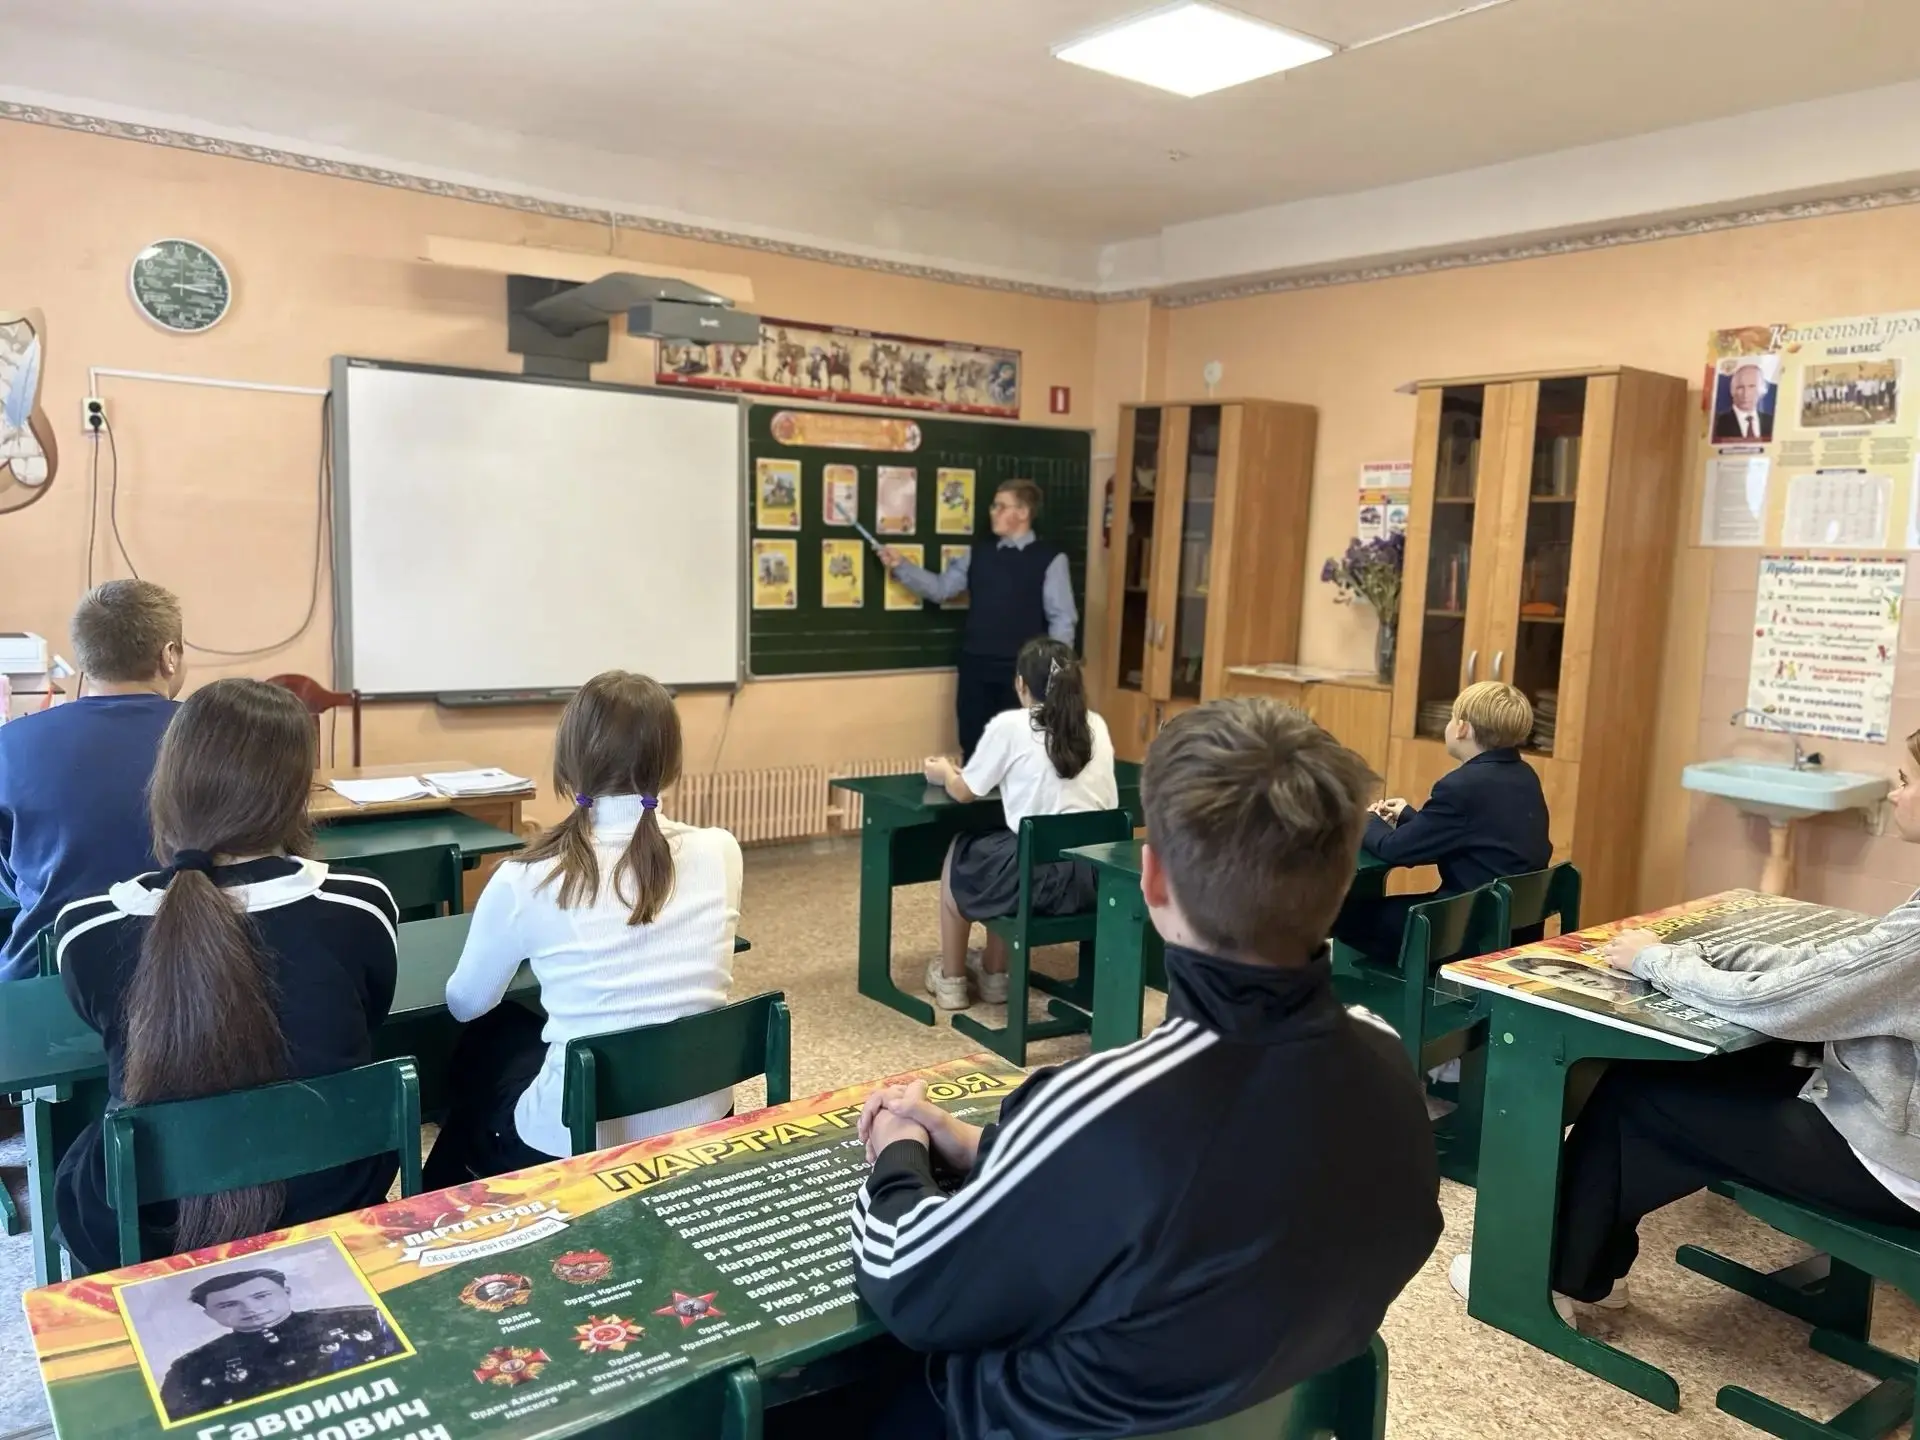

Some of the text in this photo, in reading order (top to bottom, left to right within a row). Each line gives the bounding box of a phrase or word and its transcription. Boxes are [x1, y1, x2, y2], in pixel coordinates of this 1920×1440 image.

[594, 1072, 1006, 1192] ПАРТА ГОЯ
[641, 1184, 702, 1206] Гавриил
[703, 1165, 767, 1188] Иванович
[768, 1147, 831, 1170] Игнашкин
[840, 1138, 864, 1149] Гер
[654, 1156, 847, 1217] Дата рождения: 23.02.1917 г.
[665, 1209, 711, 1227] Место
[713, 1187, 787, 1216] рождения:
[851, 1162, 876, 1173] Бо
[680, 1175, 869, 1239] Должность и звание: коман
[403, 1200, 547, 1247] ПАРТА ГЕРОЯ
[692, 1215, 790, 1249] авиационного
[792, 1201, 833, 1218] полка
[704, 1247, 732, 1261] 8-й
[733, 1222, 812, 1252] воздушной
[716, 1225, 852, 1274] Награды: орден Ле
[564, 1277, 643, 1306] Орден Красного
[733, 1266, 780, 1287] орден
[746, 1277, 798, 1299] войны
[797, 1267, 824, 1281] 1-й
[760, 1274, 856, 1313] Умер: 26 янв
[497, 1311, 532, 1325] Орден
[588, 1290, 633, 1308] Знамени
[775, 1291, 860, 1326] Похоронен
[500, 1318, 541, 1334] Ленина
[680, 1319, 762, 1351] Красной Звезды
[697, 1320, 731, 1335] Орден
[589, 1356, 689, 1395] войны 1-й степени
[592, 1351, 672, 1383] Отечественной
[608, 1351, 642, 1366] Орден
[196, 1377, 399, 1440] Гавриил
[469, 1379, 578, 1420] Орден Александра
[504, 1396, 559, 1420] Невского
